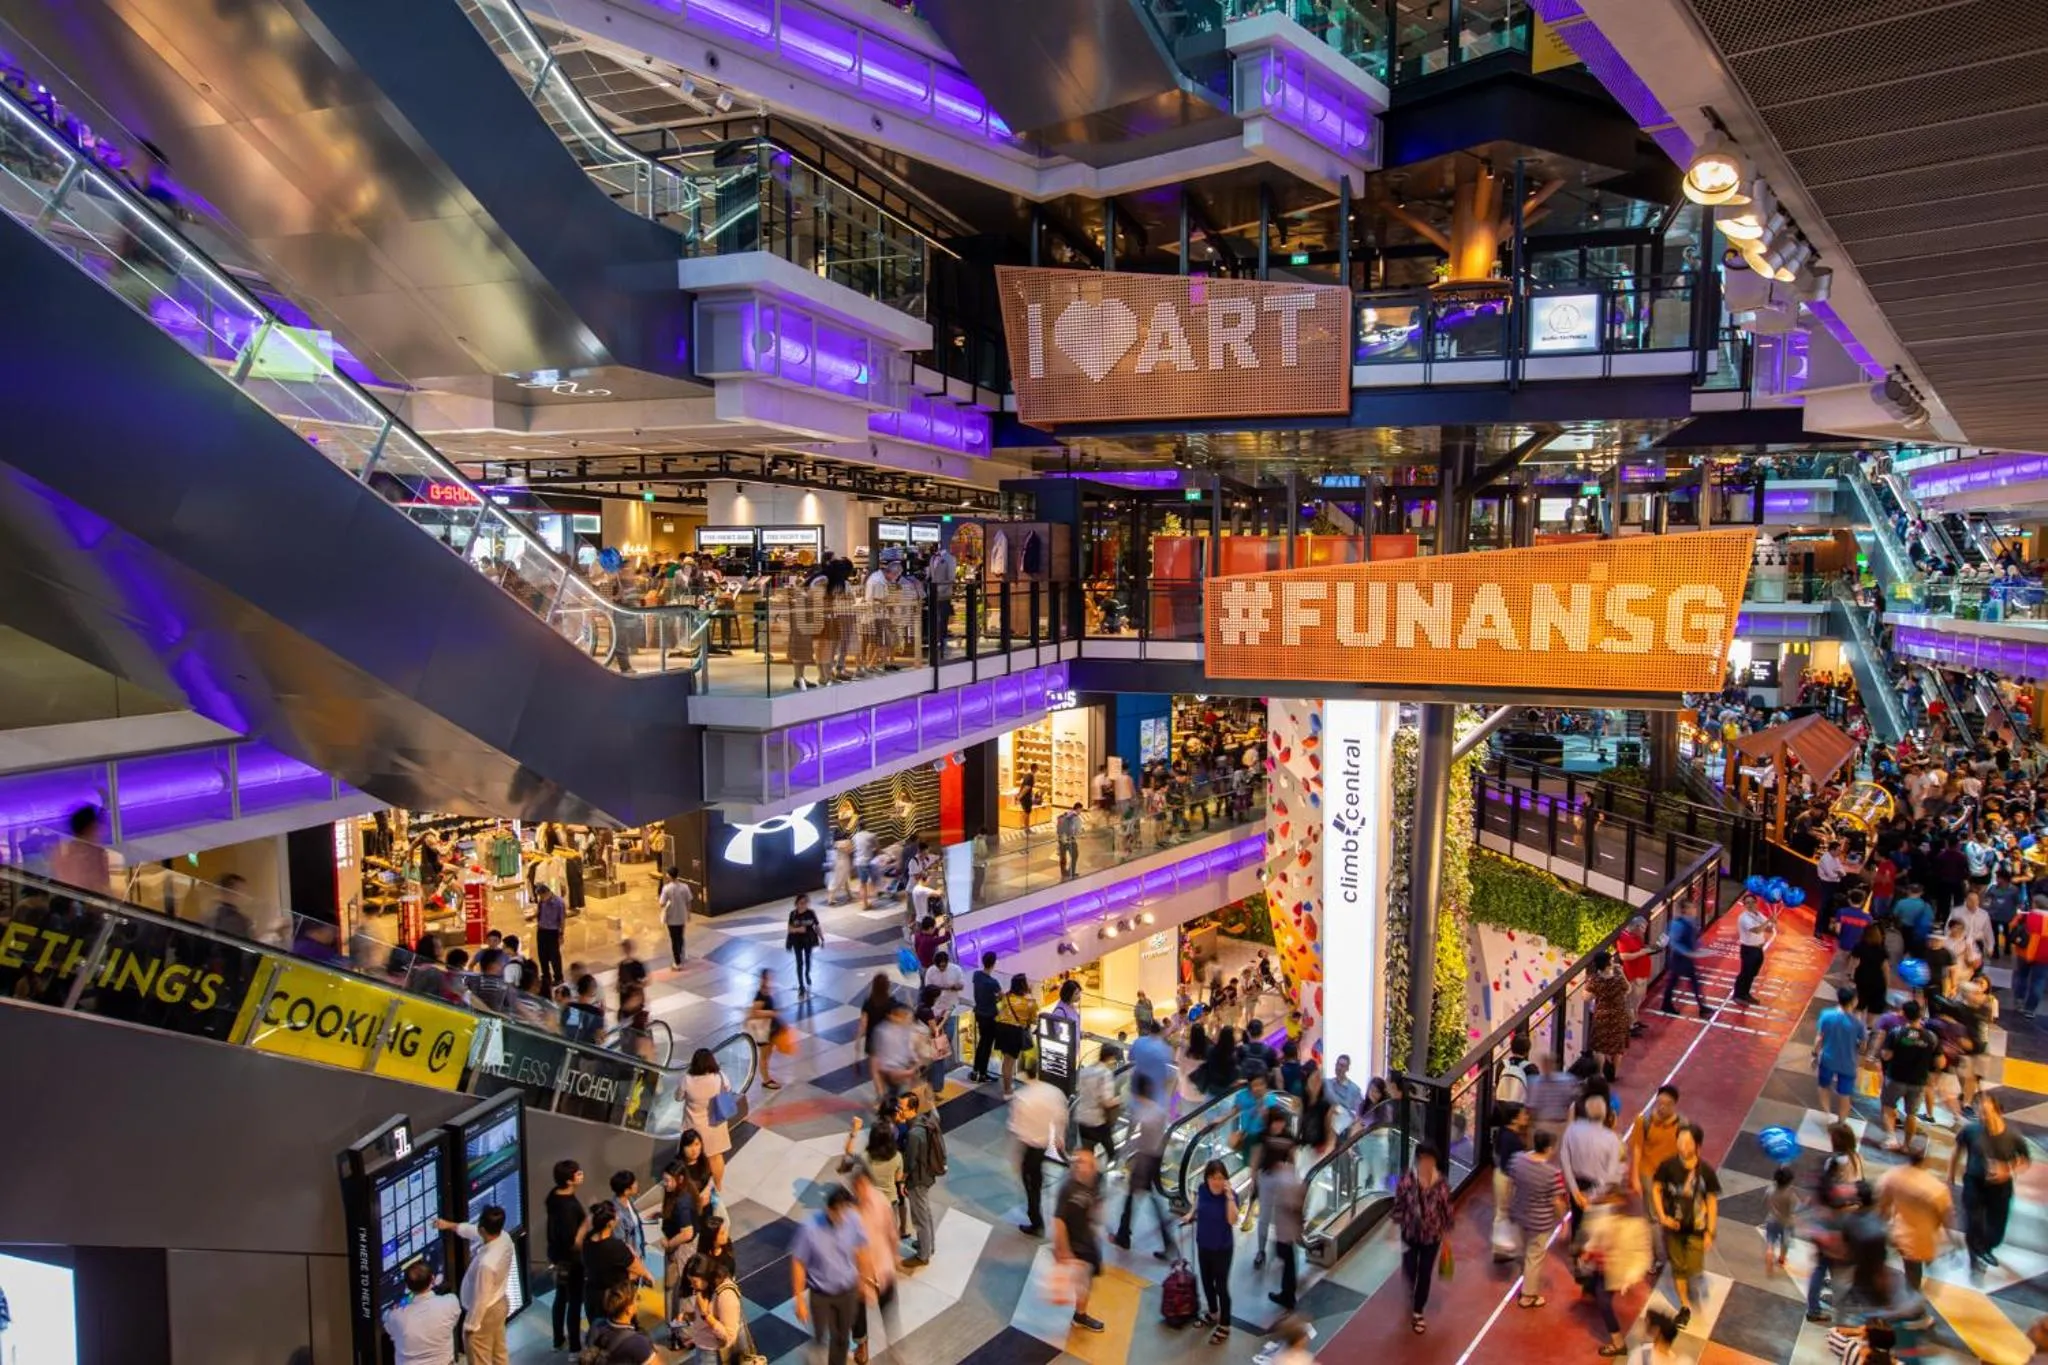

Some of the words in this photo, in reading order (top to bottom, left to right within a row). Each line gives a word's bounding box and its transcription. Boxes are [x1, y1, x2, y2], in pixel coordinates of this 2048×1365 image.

[1027, 303, 1044, 379] I
[1135, 293, 1316, 374] ART
[1219, 581, 1726, 655] #FUNANSG
[1343, 738, 1361, 821] central
[1341, 838, 1359, 903] climb
[262, 991, 422, 1058] COOKING
[395, 1126, 412, 1161] 1
[360, 1244, 369, 1271] HERE
[360, 1274, 369, 1287] TO
